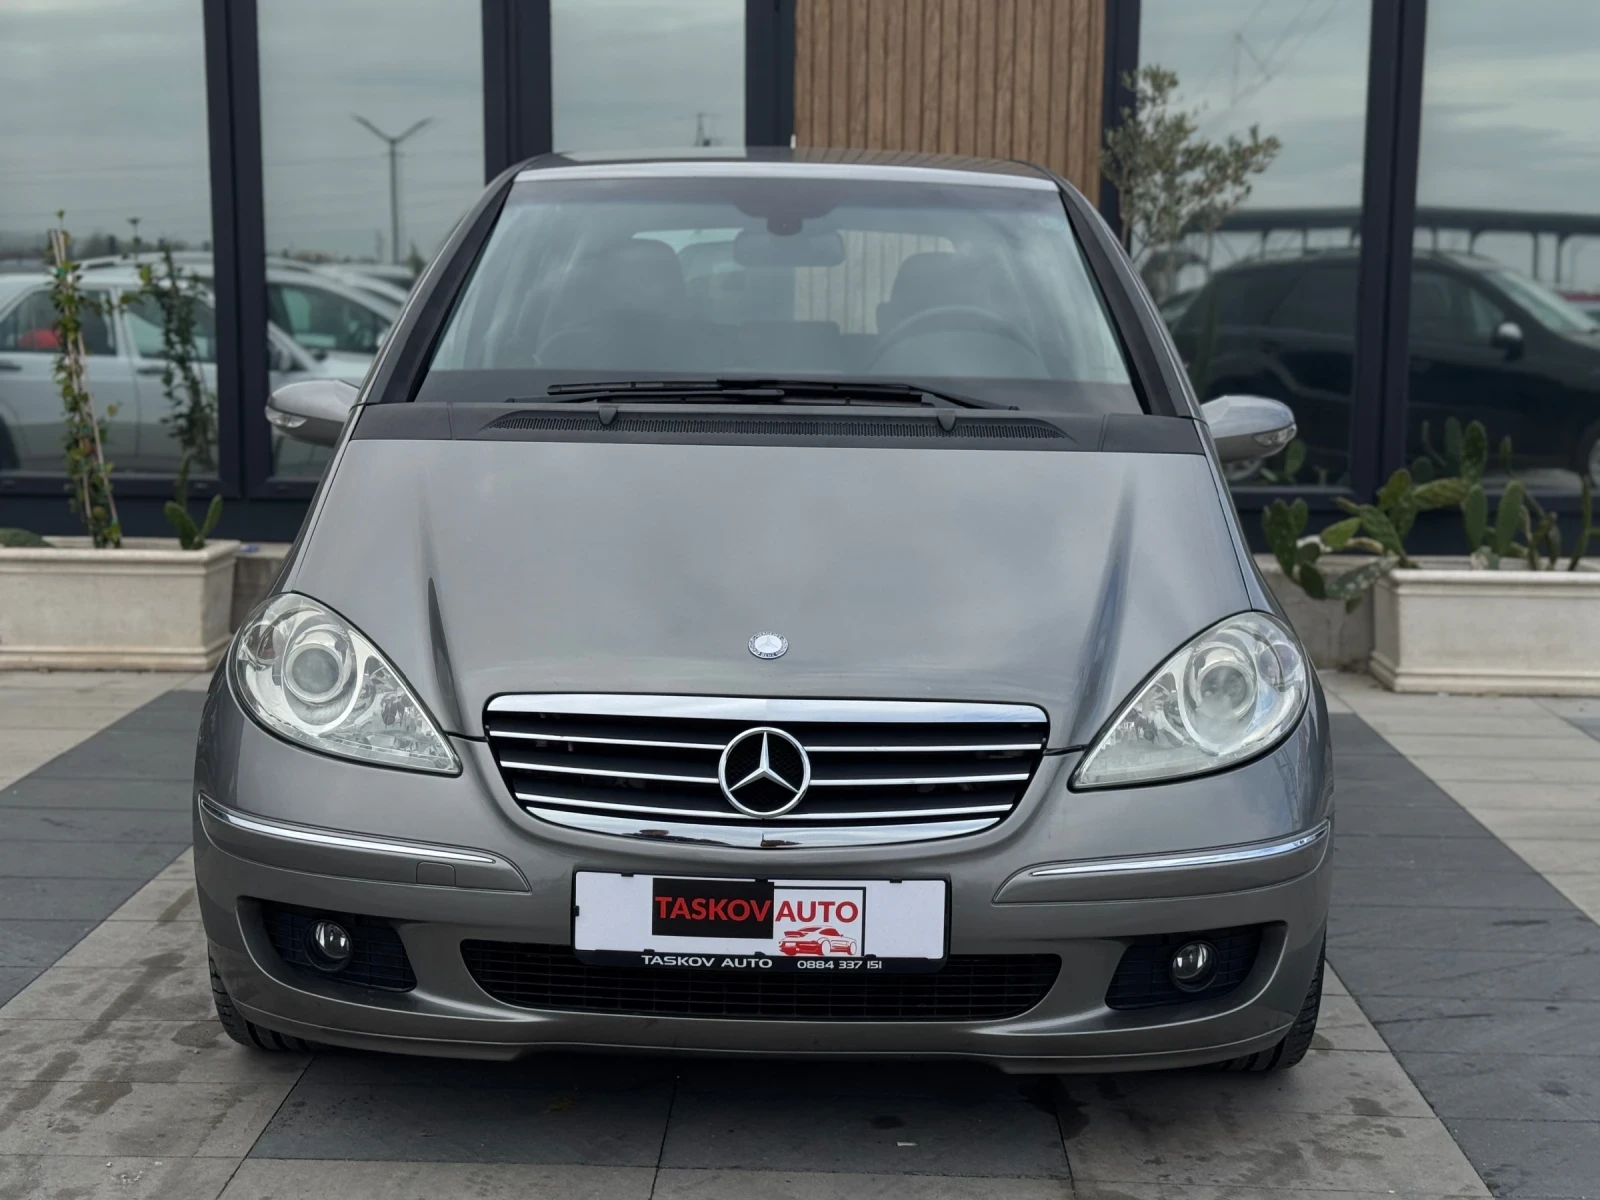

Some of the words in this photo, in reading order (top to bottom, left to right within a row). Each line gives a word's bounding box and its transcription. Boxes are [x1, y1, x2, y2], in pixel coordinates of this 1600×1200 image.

[655, 896, 772, 922] TASKOV
[775, 901, 859, 923] AUTO
[641, 955, 716, 968] TASKOV
[721, 958, 773, 969] AUTO
[797, 959, 835, 969] 0884
[838, 960, 864, 970] 337
